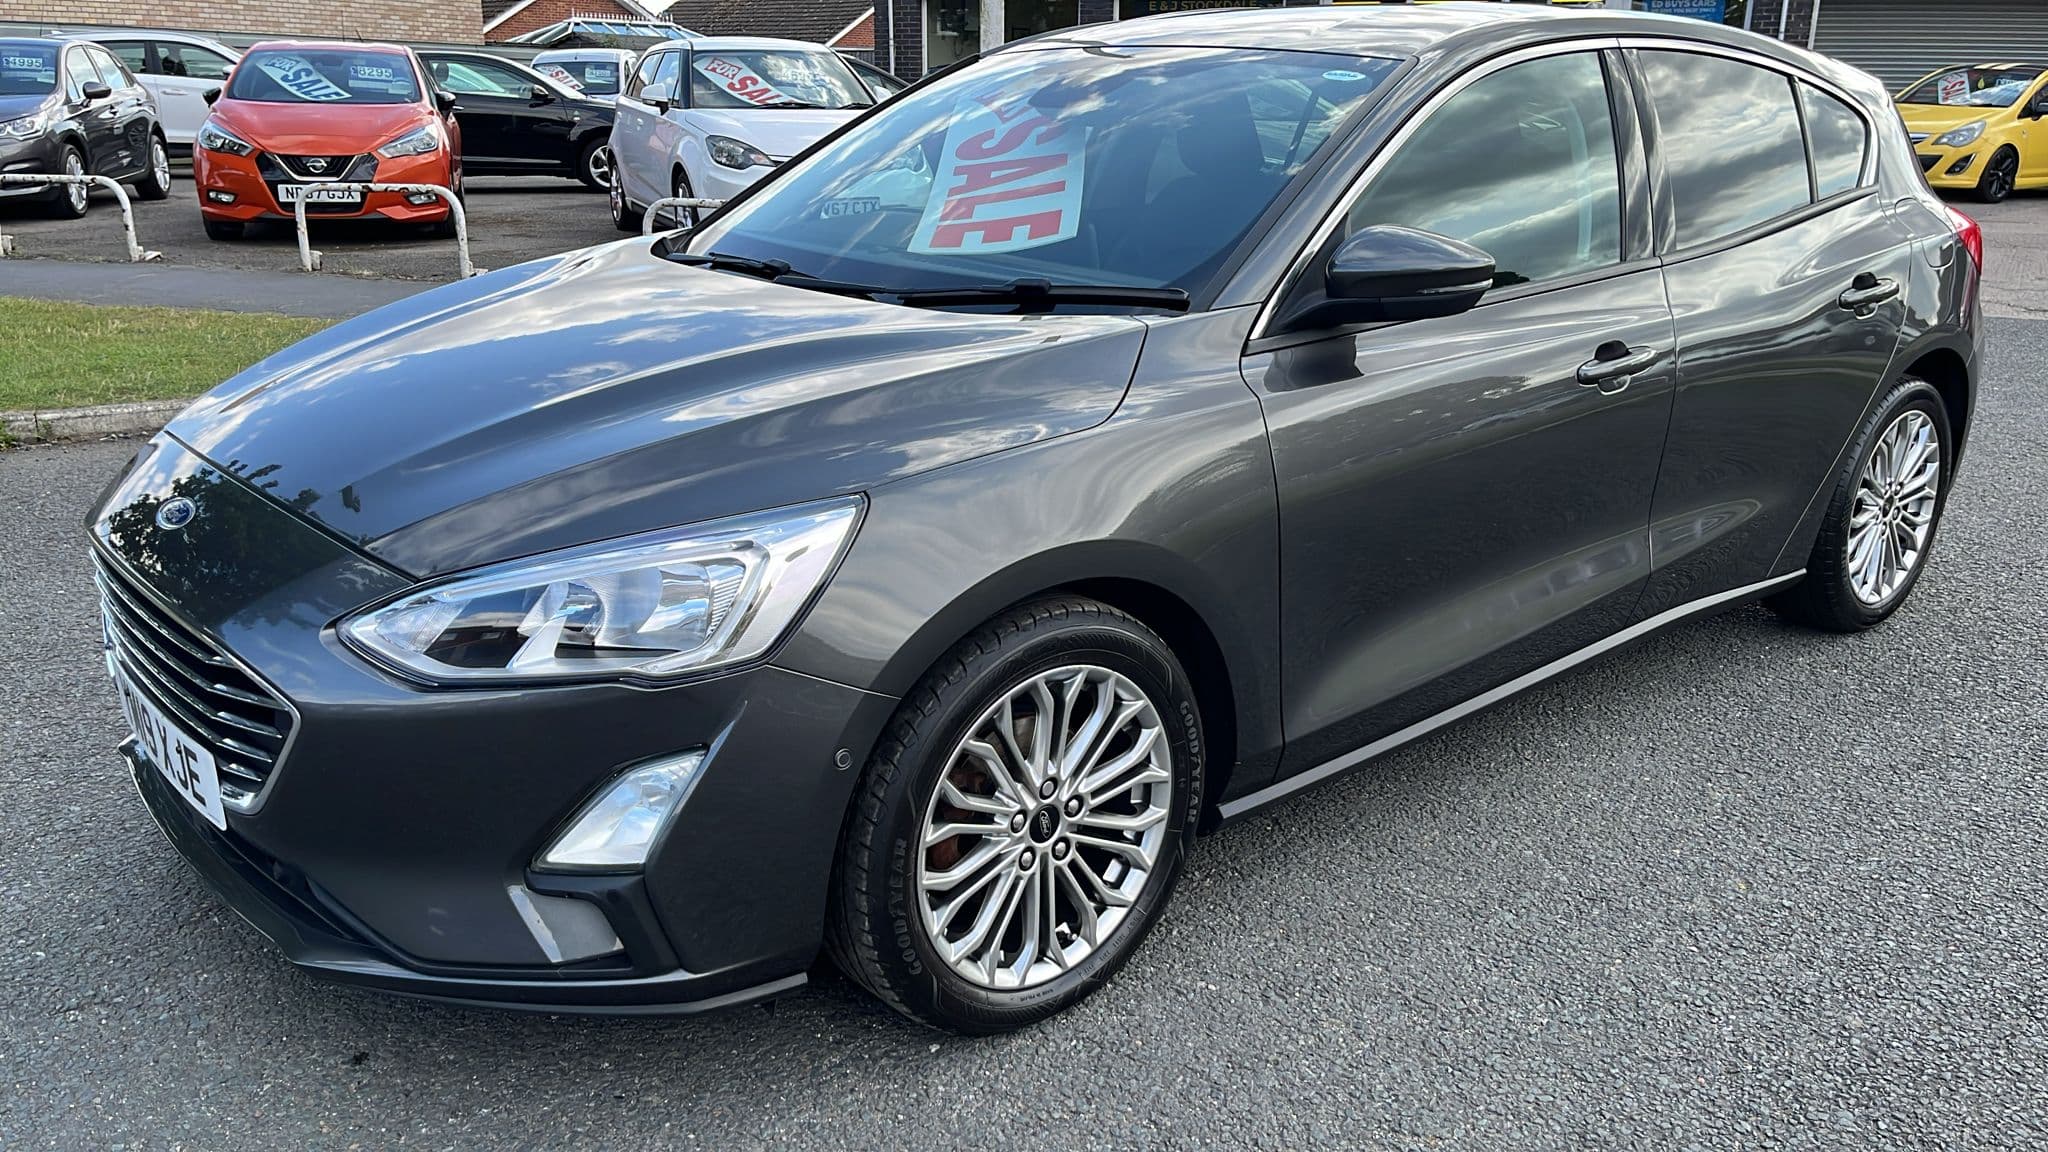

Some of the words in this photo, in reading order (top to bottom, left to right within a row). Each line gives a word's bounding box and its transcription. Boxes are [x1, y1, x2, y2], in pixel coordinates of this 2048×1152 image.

[1149, 1, 1156, 11] E
[1160, 1, 1168, 11] &
[1170, 1, 1177, 10] J
[706, 60, 738, 78] FOR
[280, 68, 342, 99] SALE
[727, 76, 784, 103] SAL
[1941, 80, 1966, 102] SAL
[327, 189, 355, 200] GJX
[929, 116, 1069, 248] SALE
[156, 719, 207, 807] XJE
[1180, 700, 1202, 824] GOODYEAR
